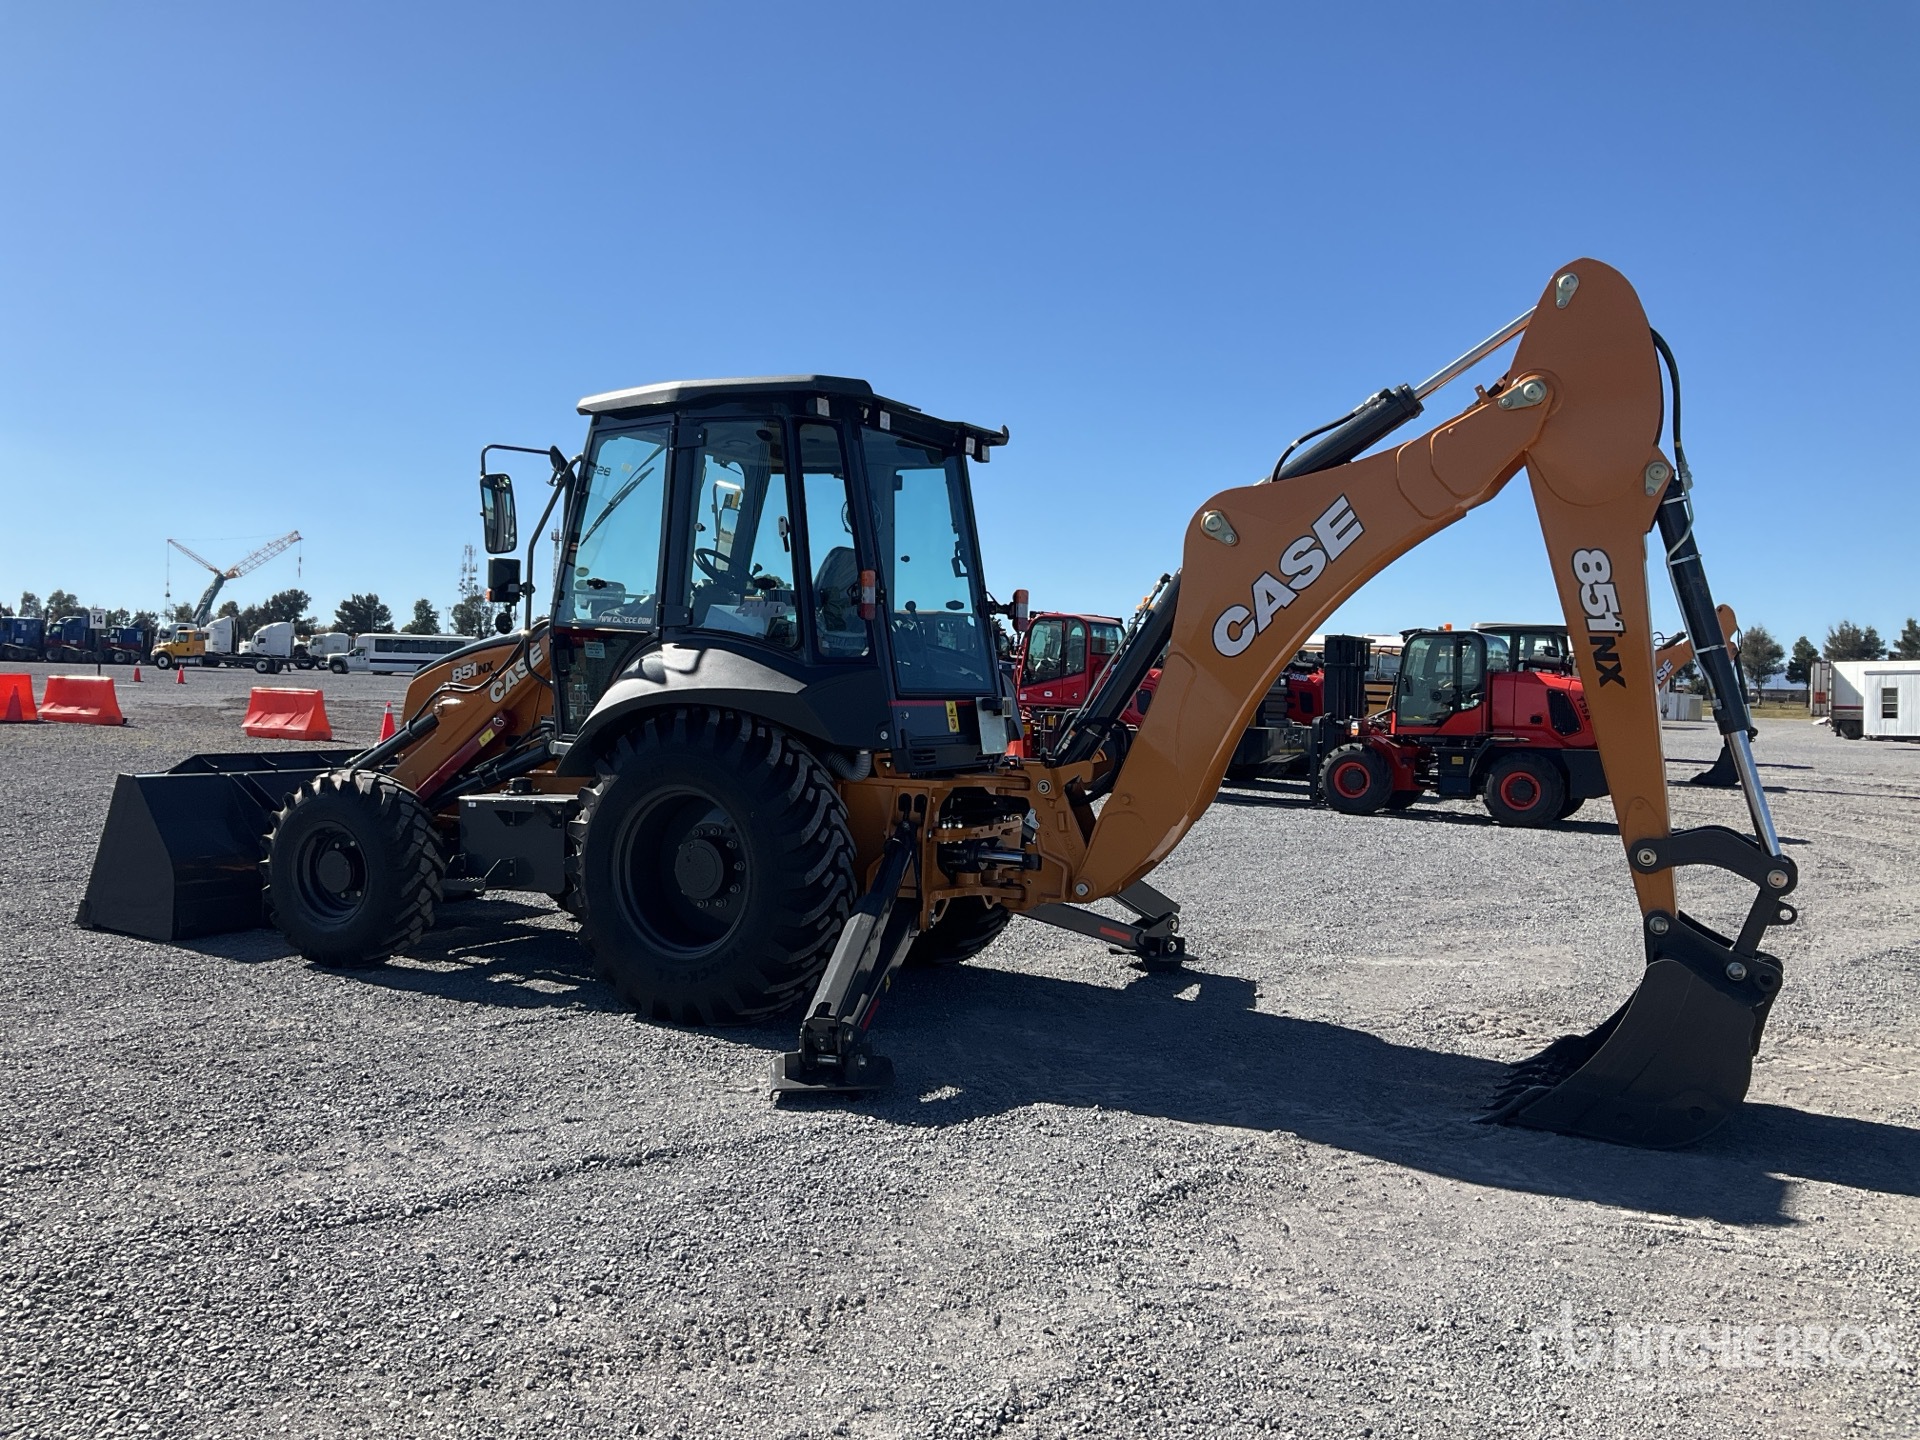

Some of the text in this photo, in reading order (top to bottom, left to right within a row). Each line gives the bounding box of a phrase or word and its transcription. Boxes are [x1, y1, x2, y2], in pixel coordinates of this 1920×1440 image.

[1212, 492, 1365, 658] CASE
[92, 615, 103, 625] 14
[735, 601, 788, 617] 4WD
[489, 643, 544, 703] CASE
